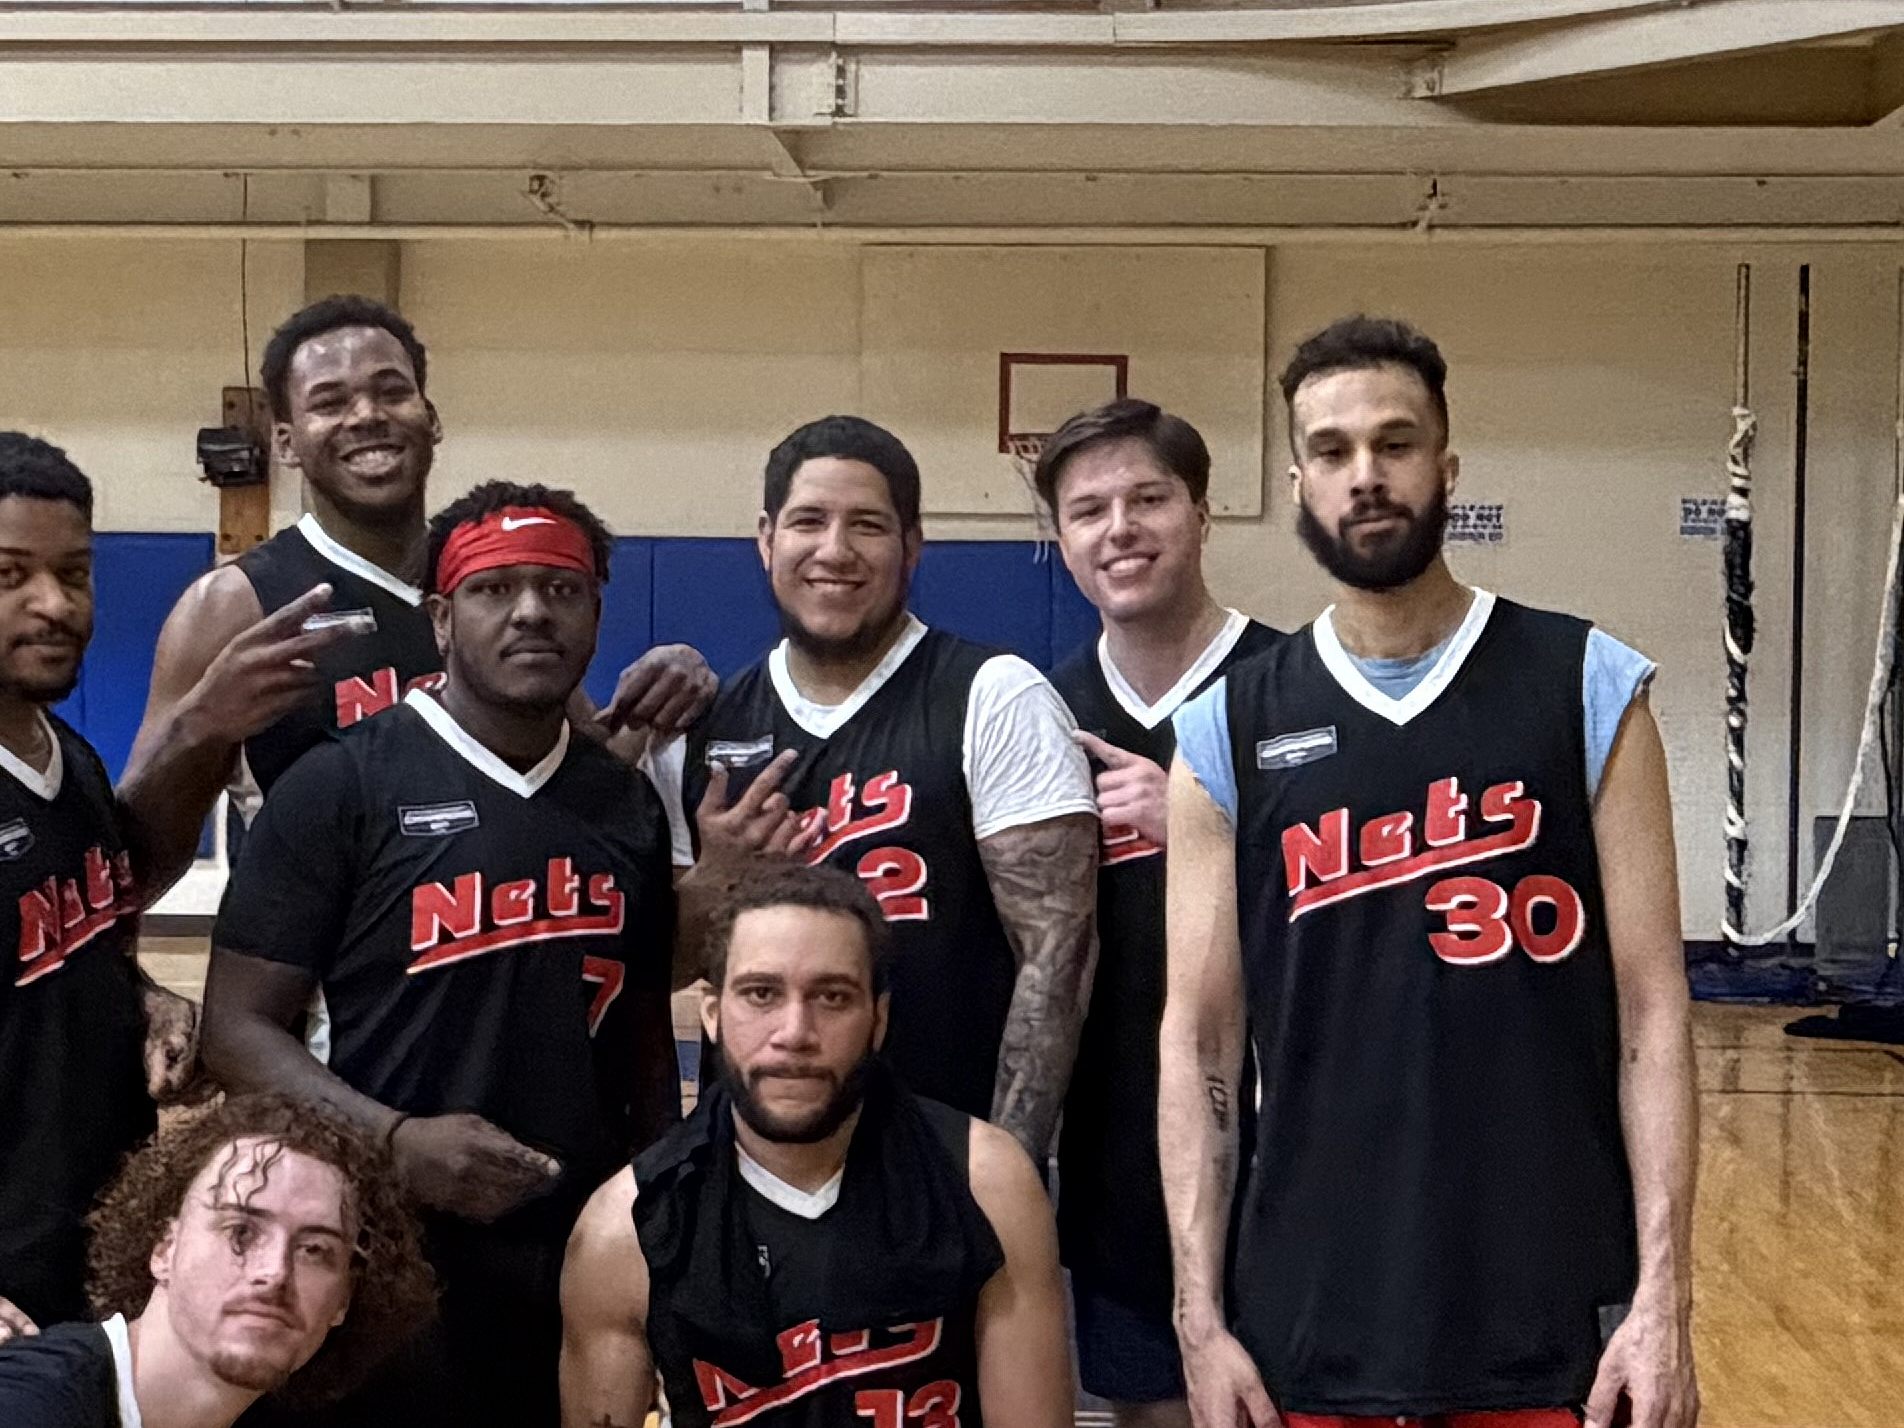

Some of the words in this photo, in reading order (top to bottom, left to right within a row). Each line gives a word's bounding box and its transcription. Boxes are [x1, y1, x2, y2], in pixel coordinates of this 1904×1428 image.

[1281, 776, 1542, 923] Nets
[407, 856, 625, 975] Nets
[1425, 875, 1584, 965] 30
[582, 955, 625, 1038] 7
